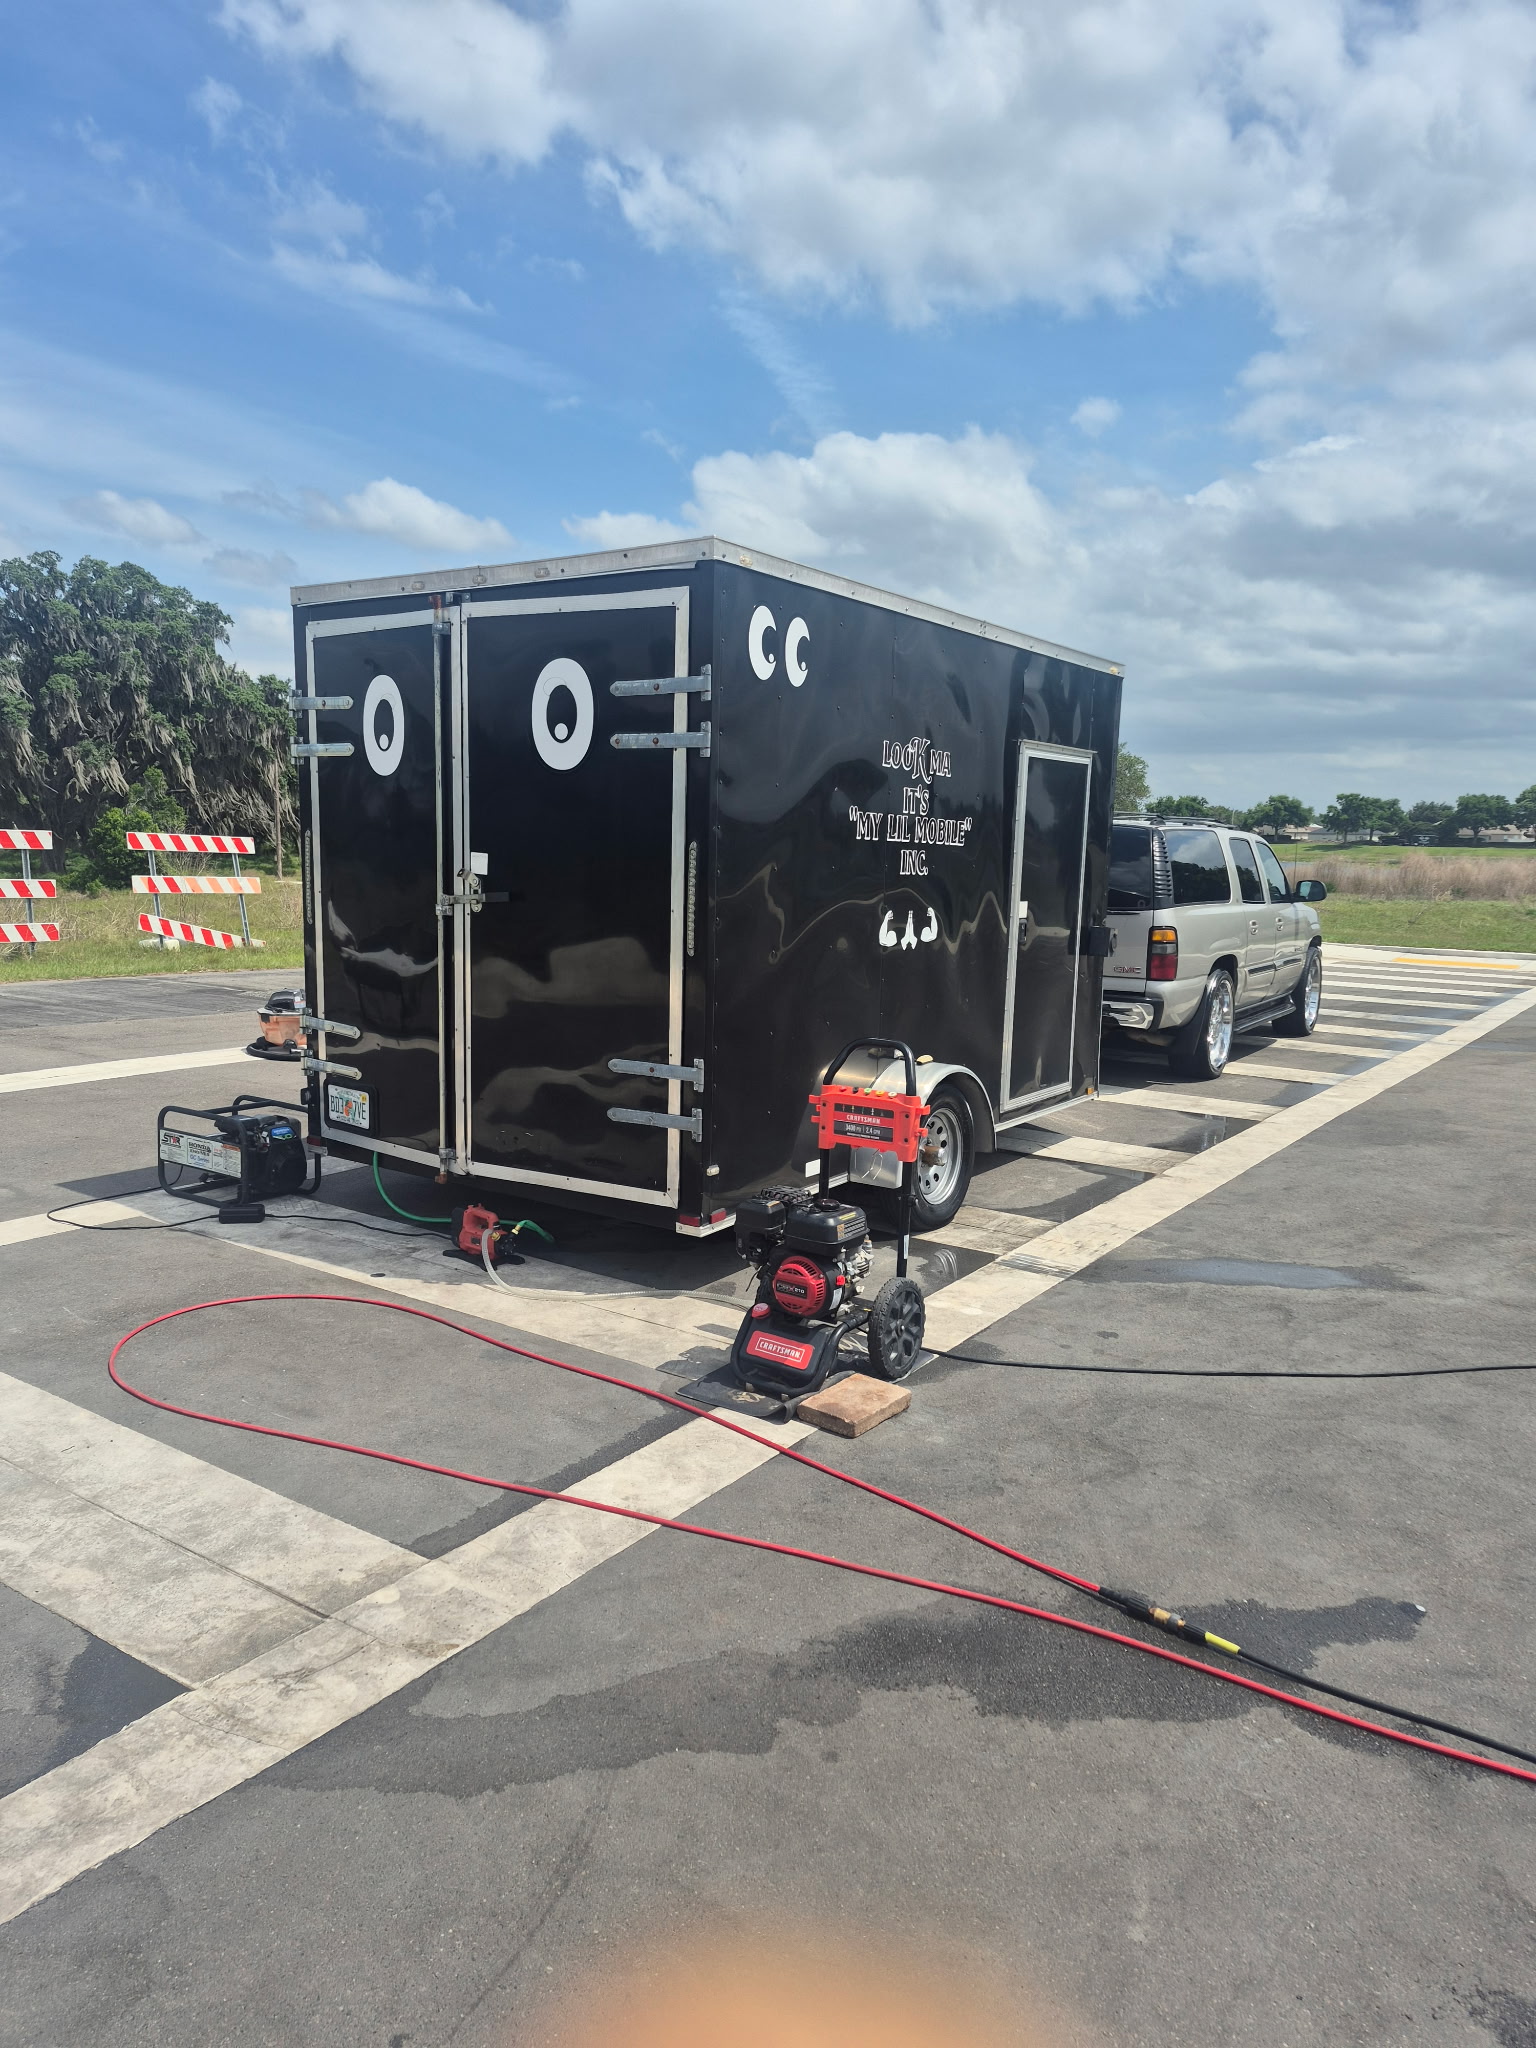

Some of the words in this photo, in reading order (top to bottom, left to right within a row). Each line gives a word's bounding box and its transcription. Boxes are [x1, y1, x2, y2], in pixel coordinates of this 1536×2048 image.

[882, 737, 932, 784] LOOK
[929, 749, 952, 777] MA
[902, 784, 930, 816] IT'S
[849, 806, 883, 841] "MY
[887, 814, 911, 843] LIL
[914, 817, 973, 847] MOBILE"
[900, 850, 929, 876] INC.
[1113, 965, 1142, 974] GMC
[846, 1114, 881, 1124] CRAFTSMAN
[188, 1141, 211, 1153] HONDA
[759, 1341, 801, 1359] CRAFTSMAN
